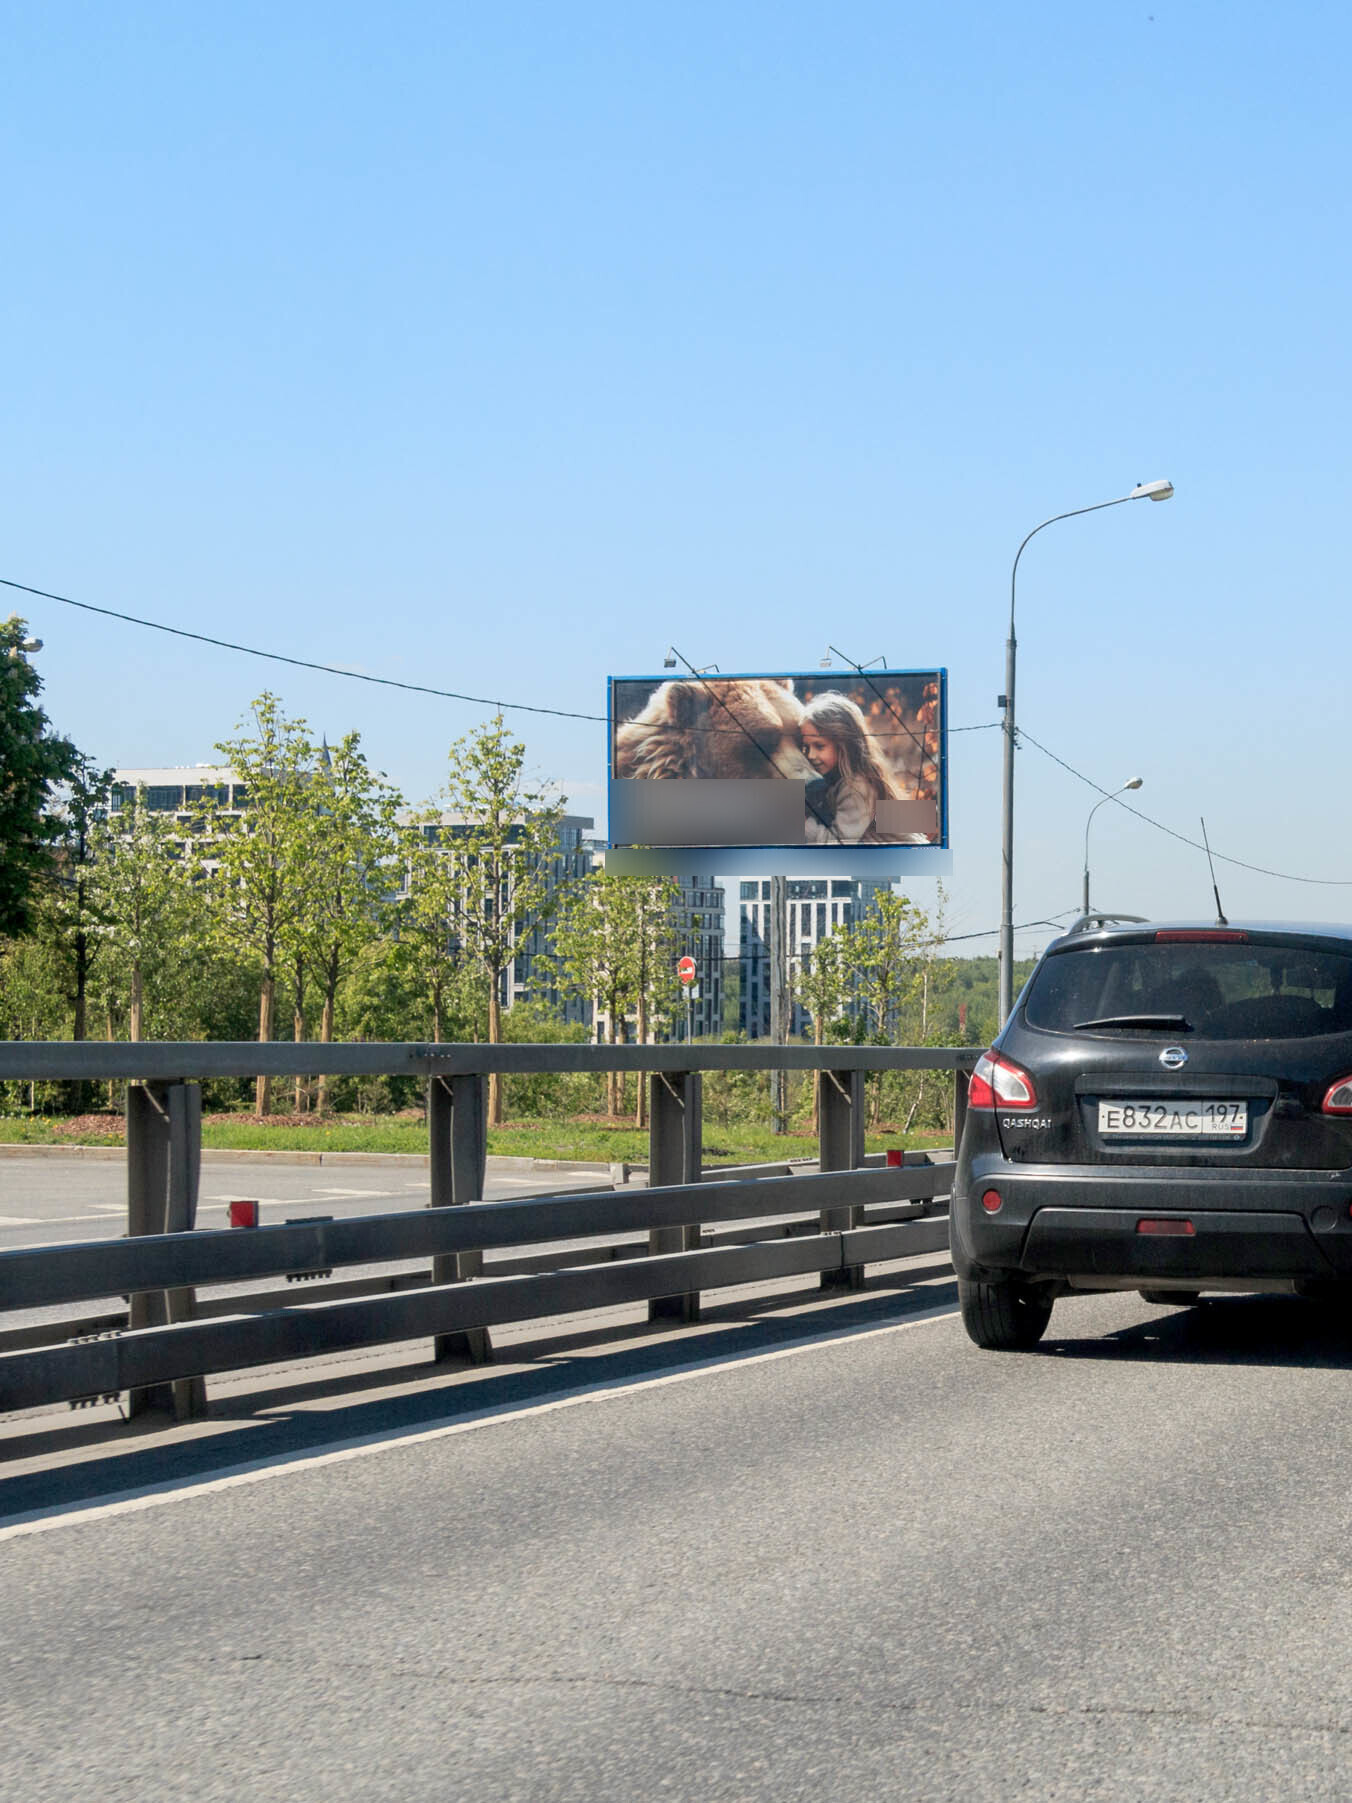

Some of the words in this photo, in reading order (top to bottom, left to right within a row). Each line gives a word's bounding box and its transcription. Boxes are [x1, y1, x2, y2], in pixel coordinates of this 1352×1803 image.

[1003, 1118, 1052, 1129] QASHQAI
[1107, 1105, 1198, 1129] E832AC
[1205, 1104, 1240, 1123] 197
